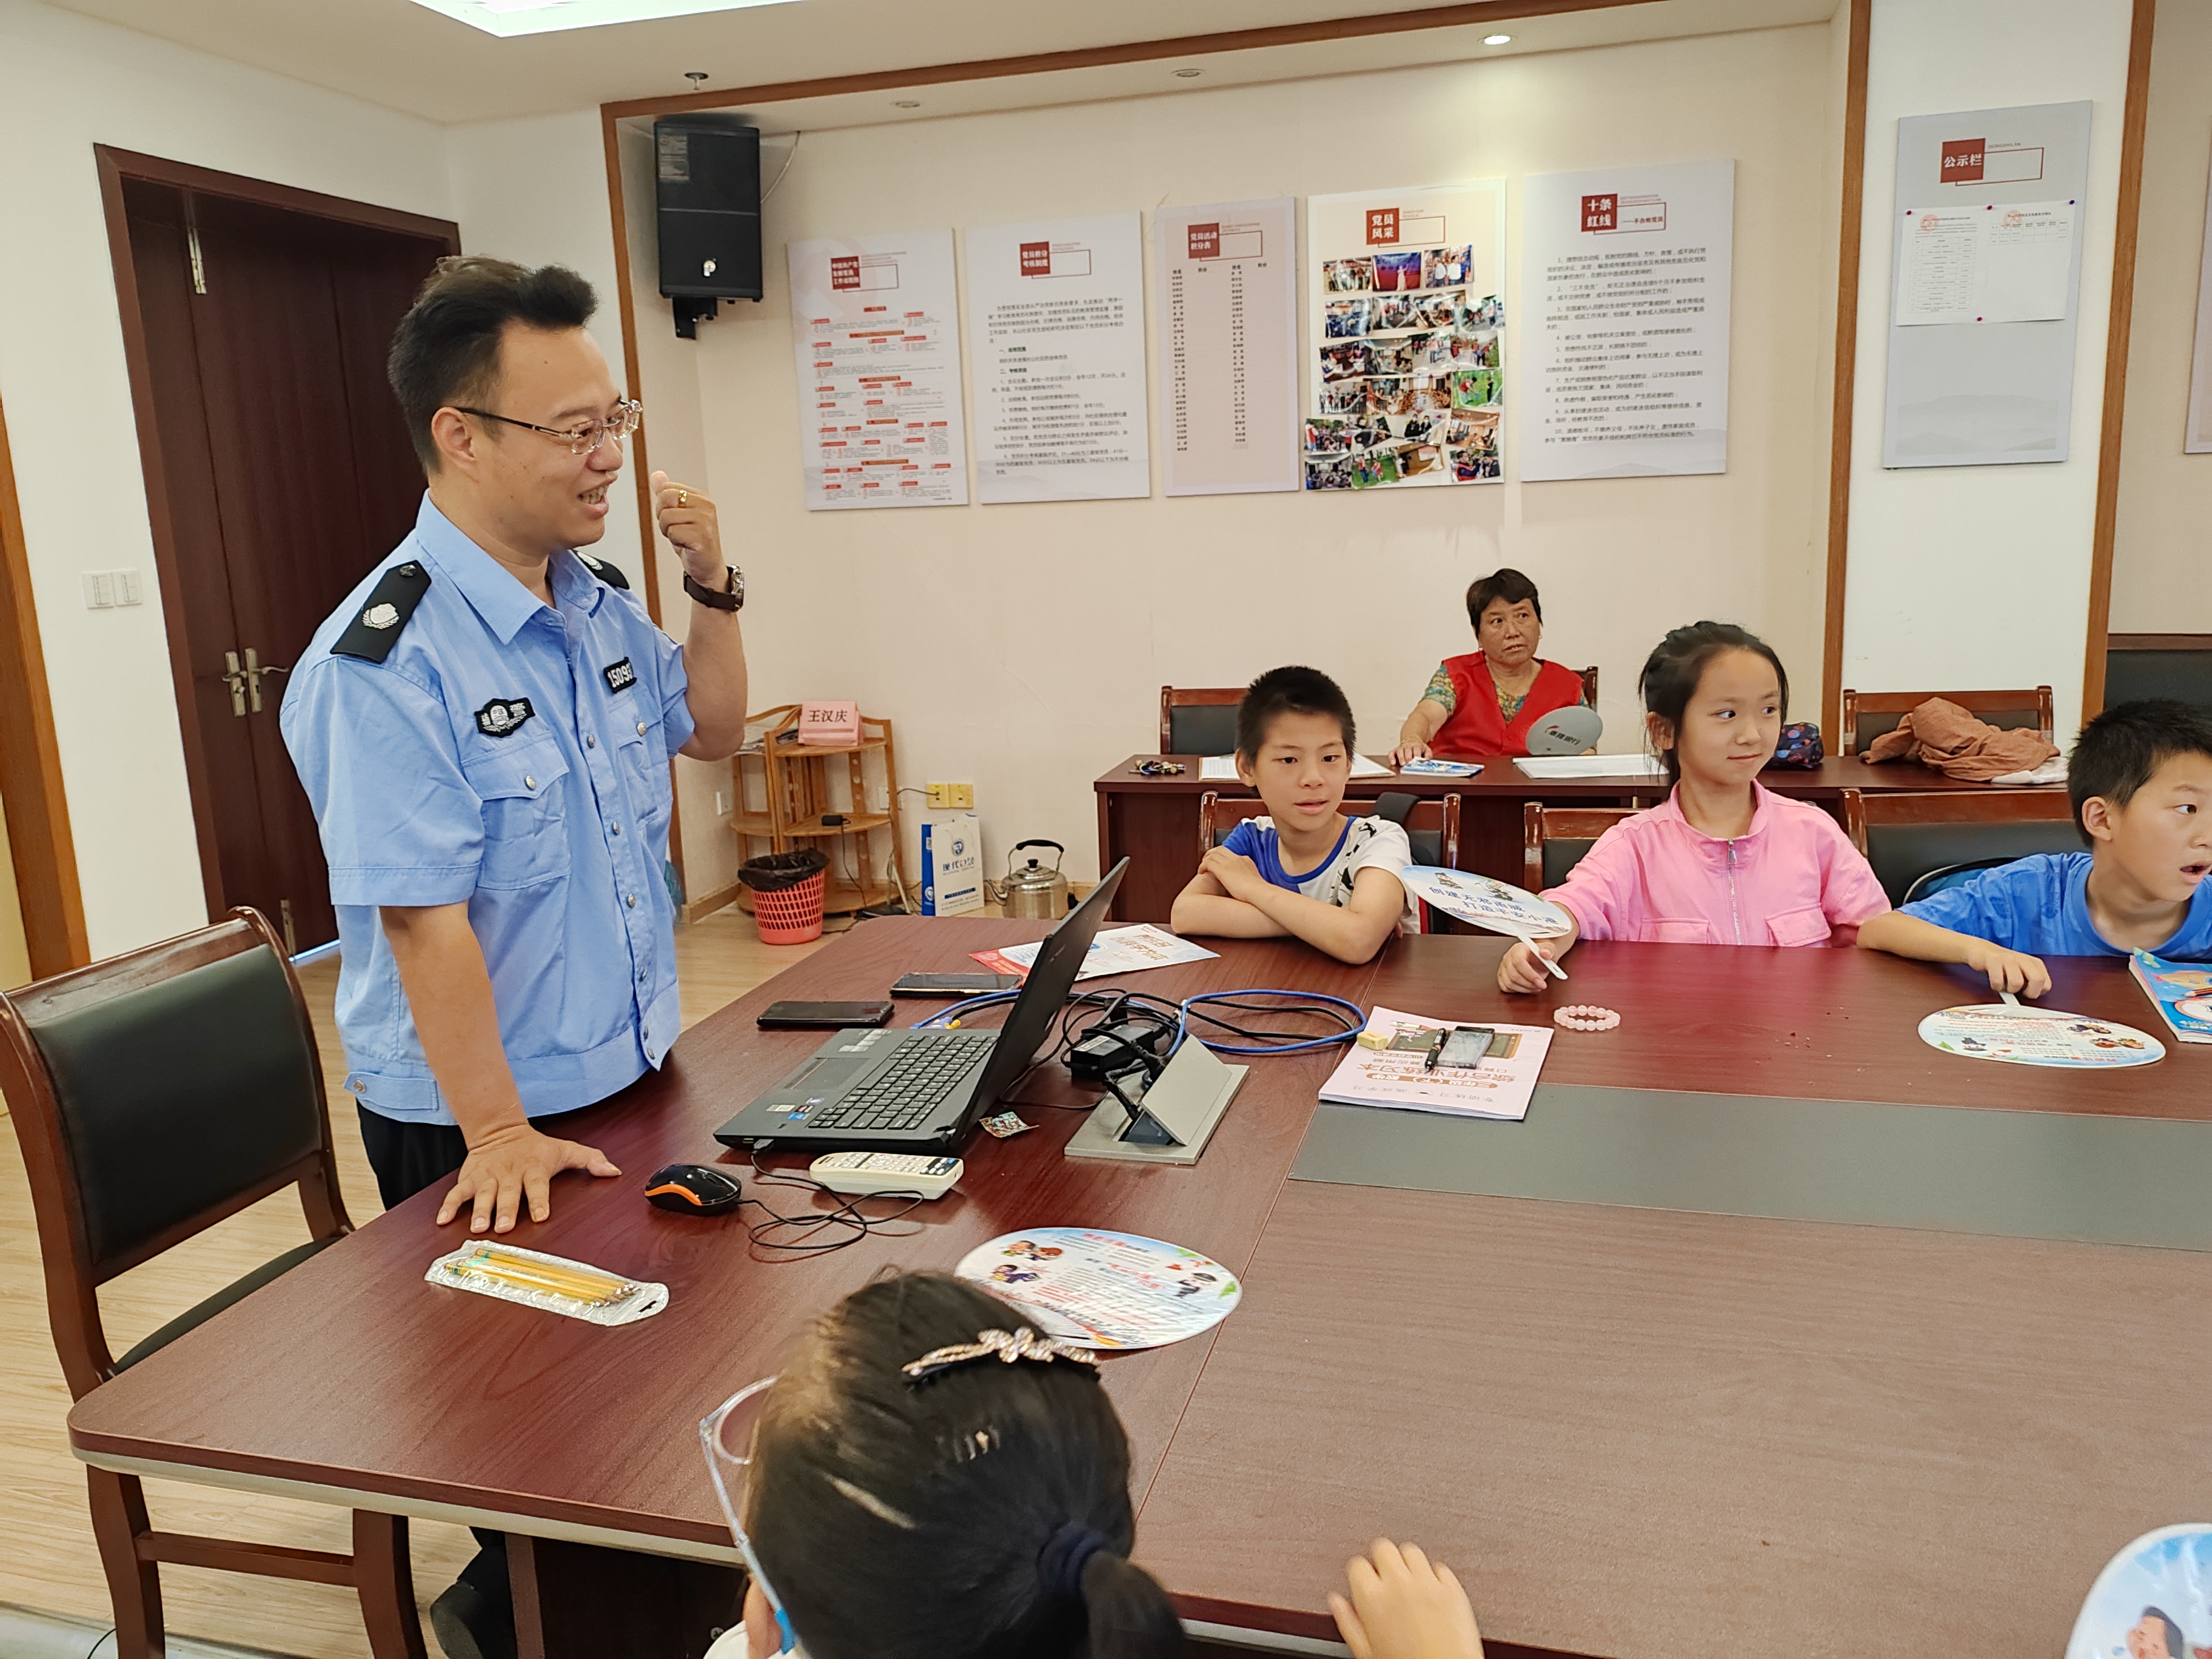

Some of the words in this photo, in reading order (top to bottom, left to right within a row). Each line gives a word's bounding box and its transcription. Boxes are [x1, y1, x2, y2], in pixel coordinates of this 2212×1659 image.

[1944, 153, 1982, 169] 公示栏
[1587, 198, 1612, 212] 十条
[1372, 213, 1394, 226] 党员
[1587, 213, 1612, 228] 红线
[1190, 232, 1218, 241] 党员活动
[1372, 227, 1395, 240] 风采
[1191, 241, 1211, 250] 积分表
[808, 709, 848, 723] 王汉庆
[1356, 1062, 1517, 1084] 综合作业练习本
